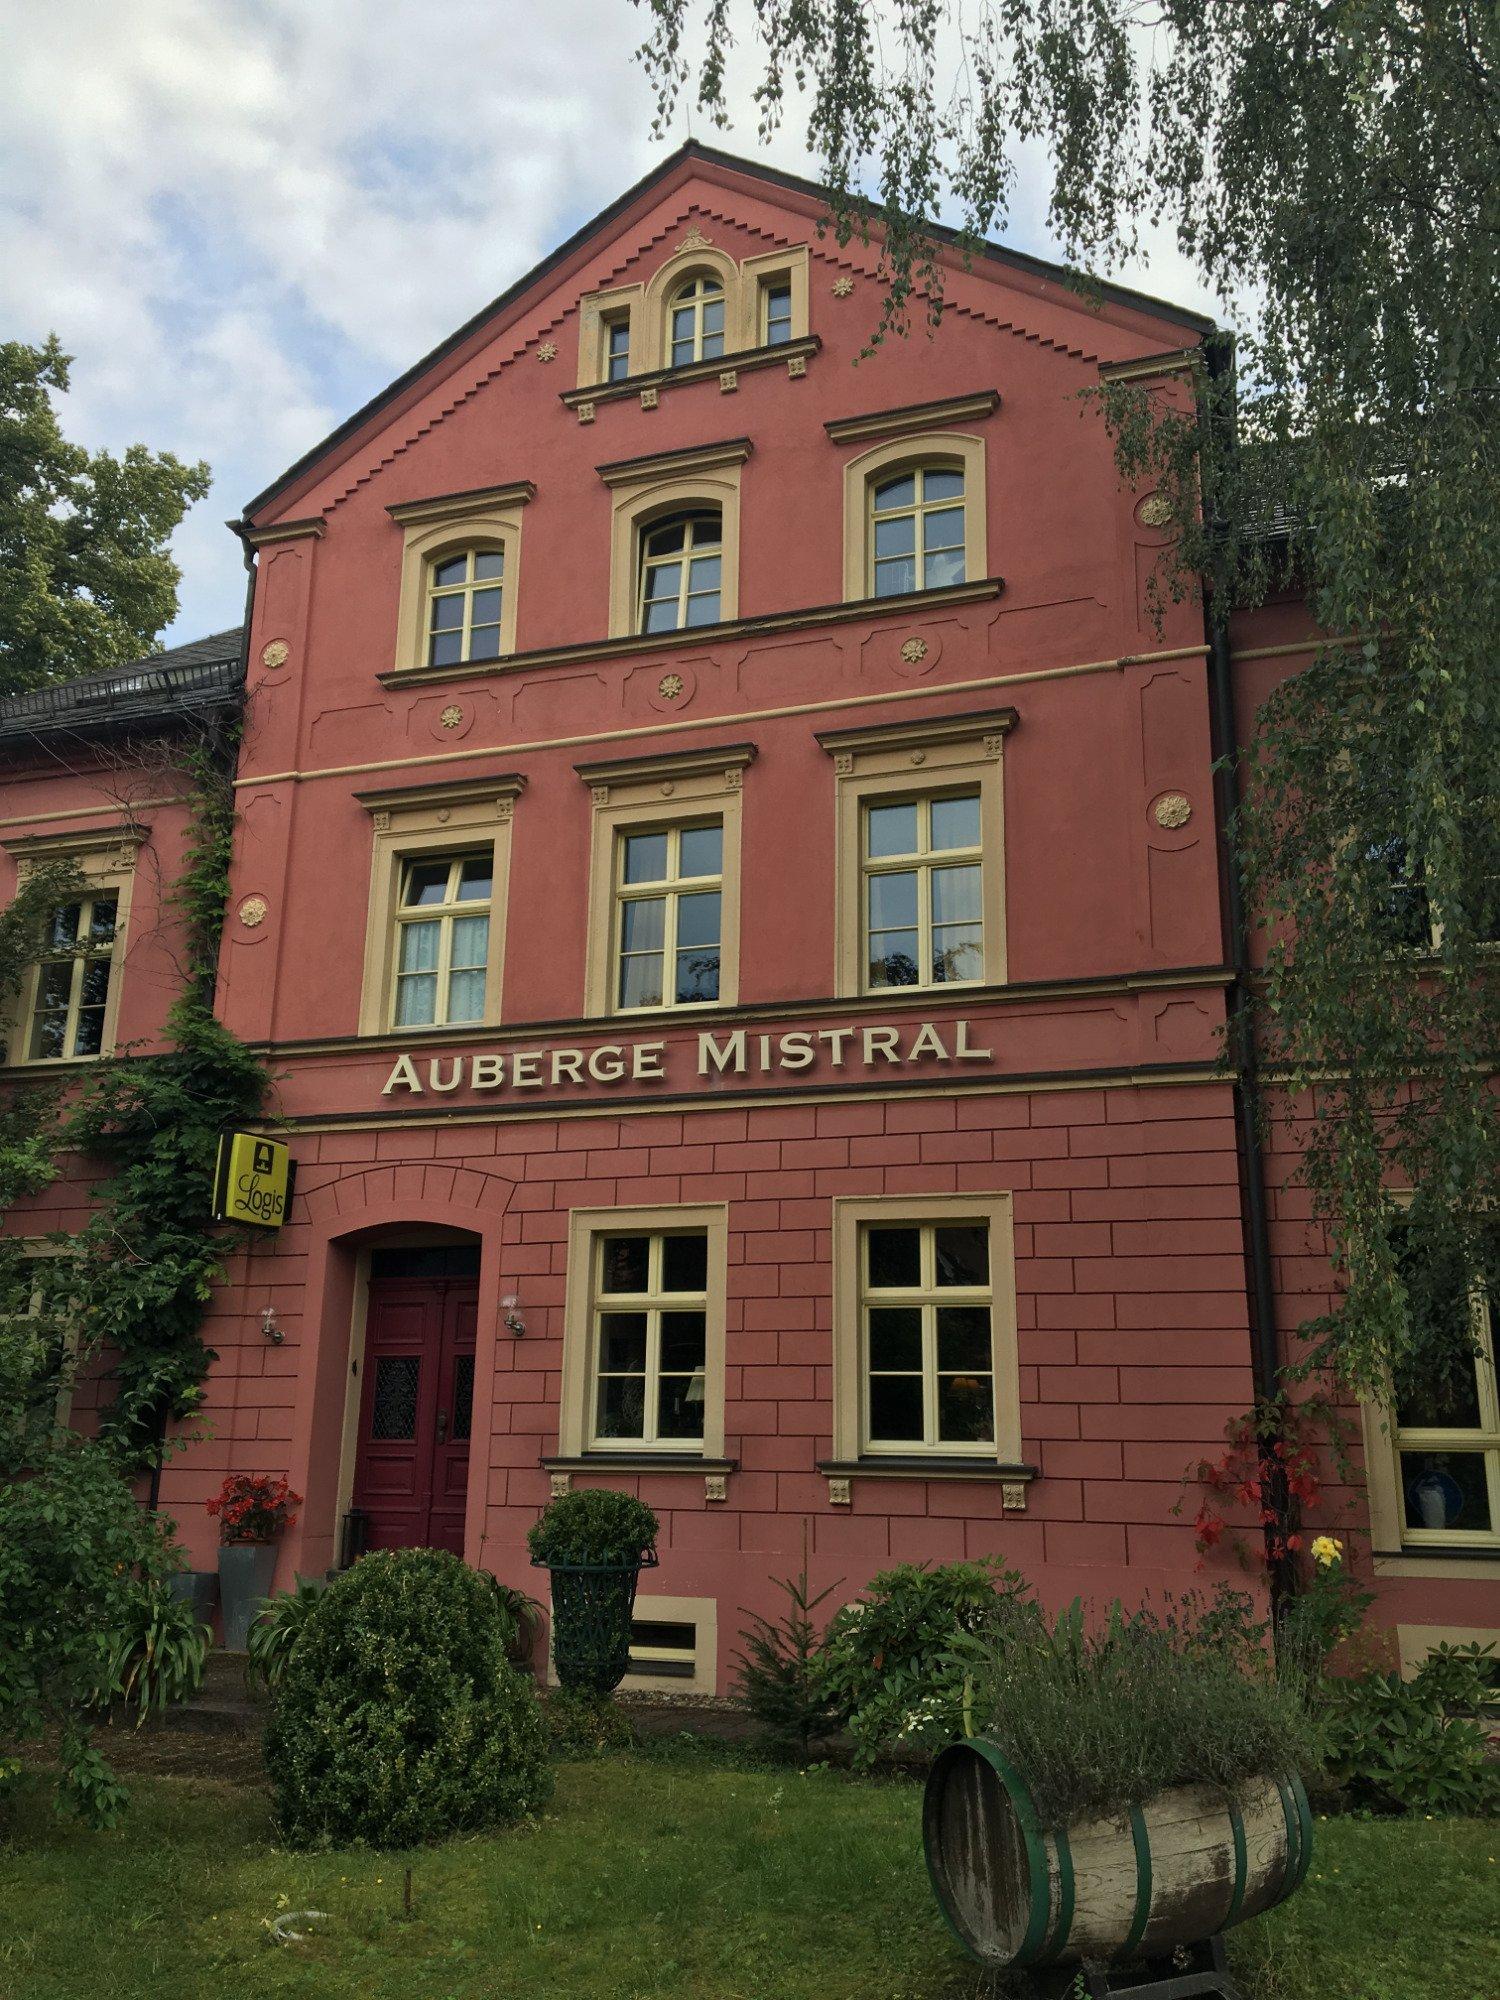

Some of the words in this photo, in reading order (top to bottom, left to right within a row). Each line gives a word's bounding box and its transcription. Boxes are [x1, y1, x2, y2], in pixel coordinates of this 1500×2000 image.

[381, 1040, 667, 1096] AUBERGE
[697, 1020, 992, 1075] MISTRAL
[234, 1174, 284, 1221] Logis
